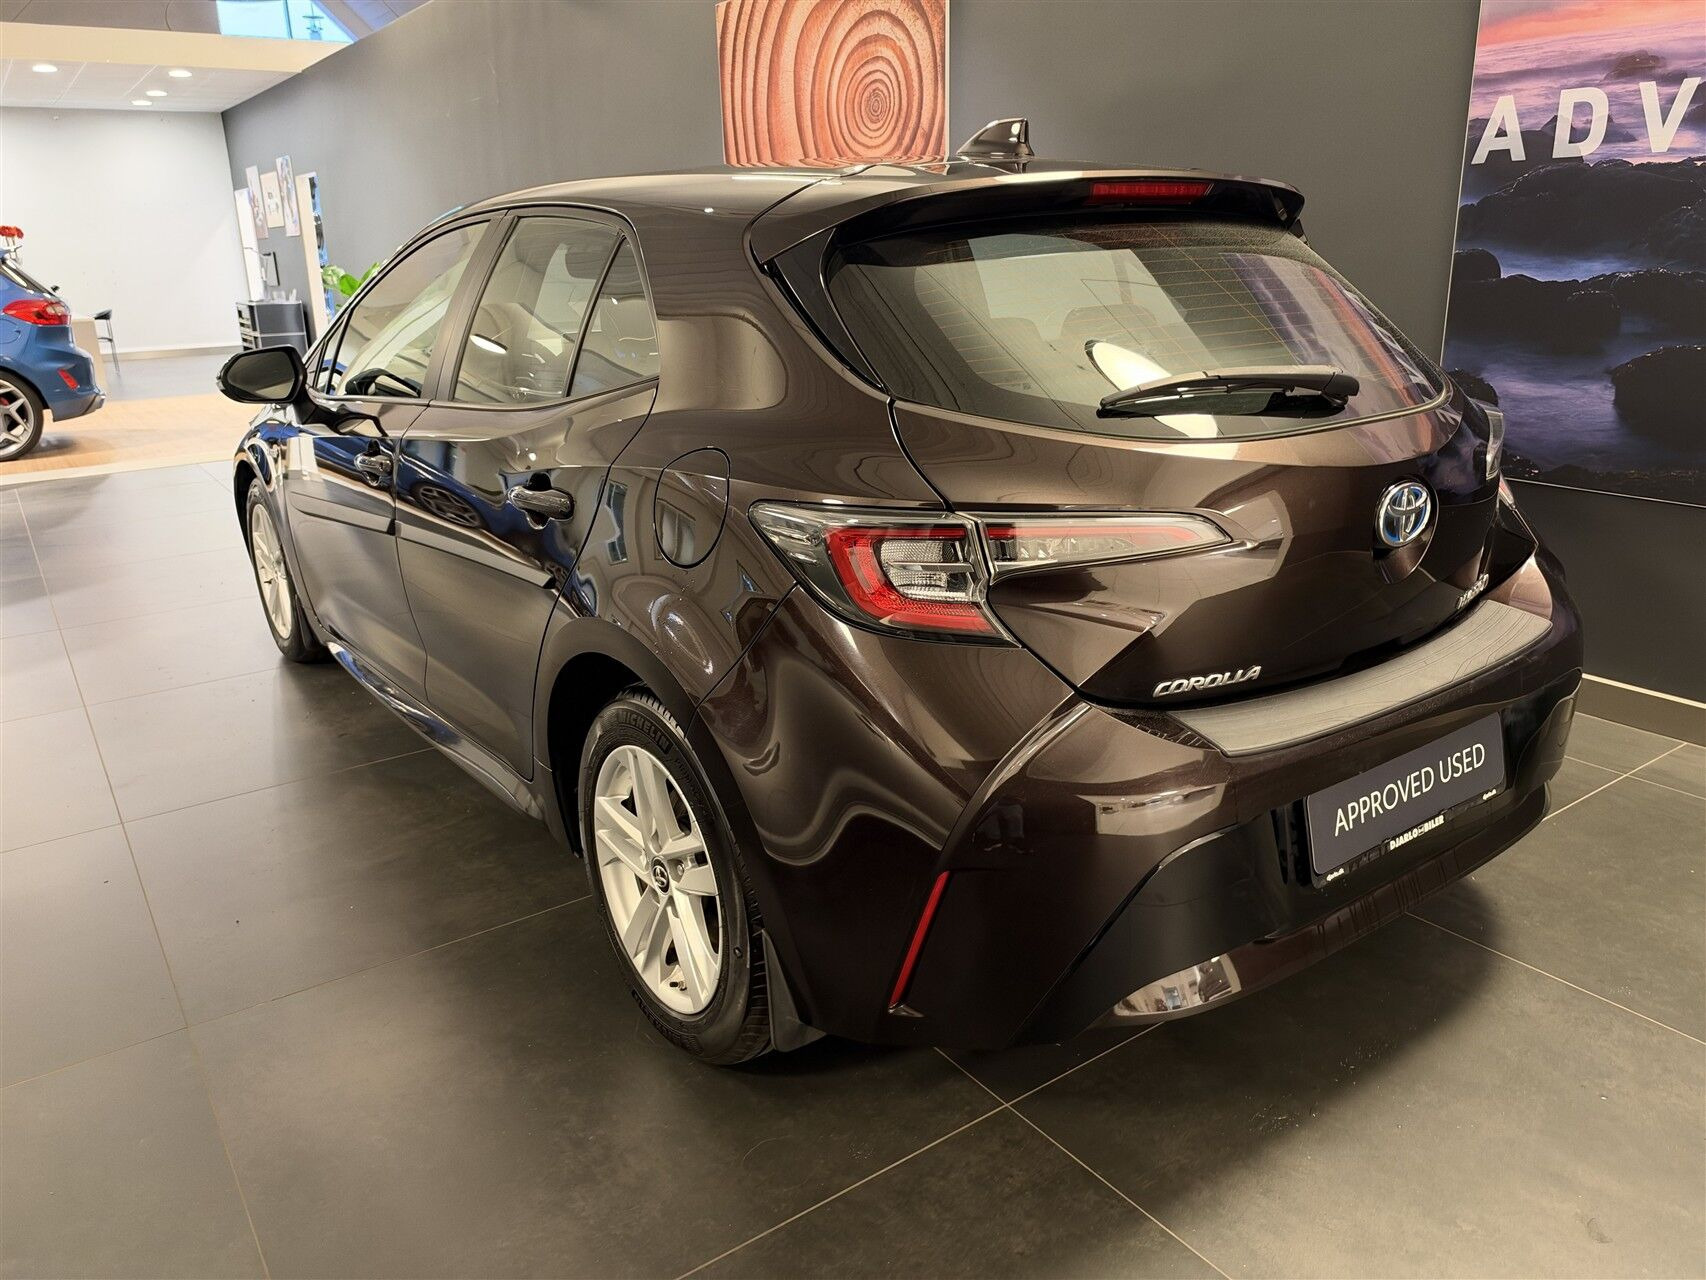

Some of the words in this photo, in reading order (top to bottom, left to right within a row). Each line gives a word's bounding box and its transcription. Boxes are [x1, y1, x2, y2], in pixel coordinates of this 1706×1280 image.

[1471, 76, 1702, 165] ADV
[1152, 665, 1262, 698] COROLLA
[617, 710, 672, 753] MICHELIN
[1334, 766, 1435, 837] APPROVED
[1439, 743, 1486, 784] USED
